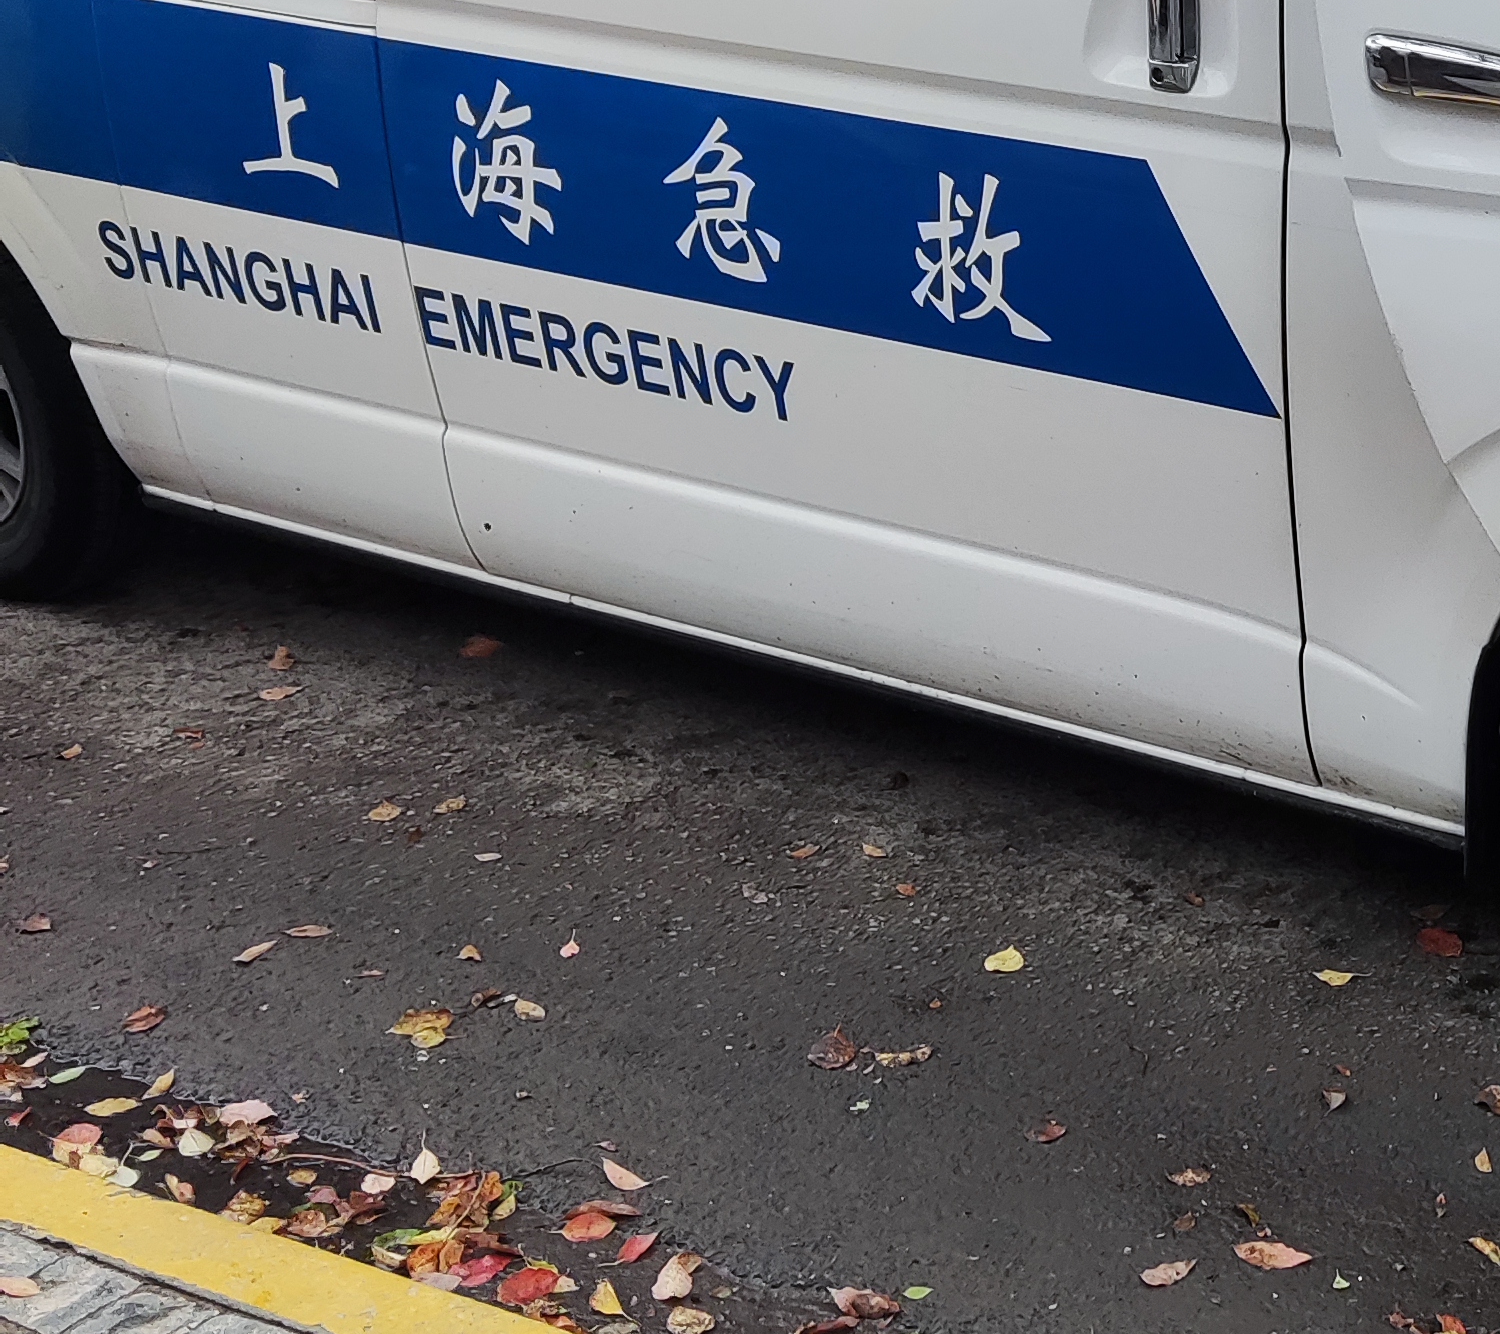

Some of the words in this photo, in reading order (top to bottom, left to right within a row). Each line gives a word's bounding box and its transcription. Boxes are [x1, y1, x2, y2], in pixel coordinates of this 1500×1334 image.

[98, 220, 382, 334] SHANGHAI
[412, 285, 795, 421] EMERGENCY
[243, 62, 1052, 343] 上海急救
